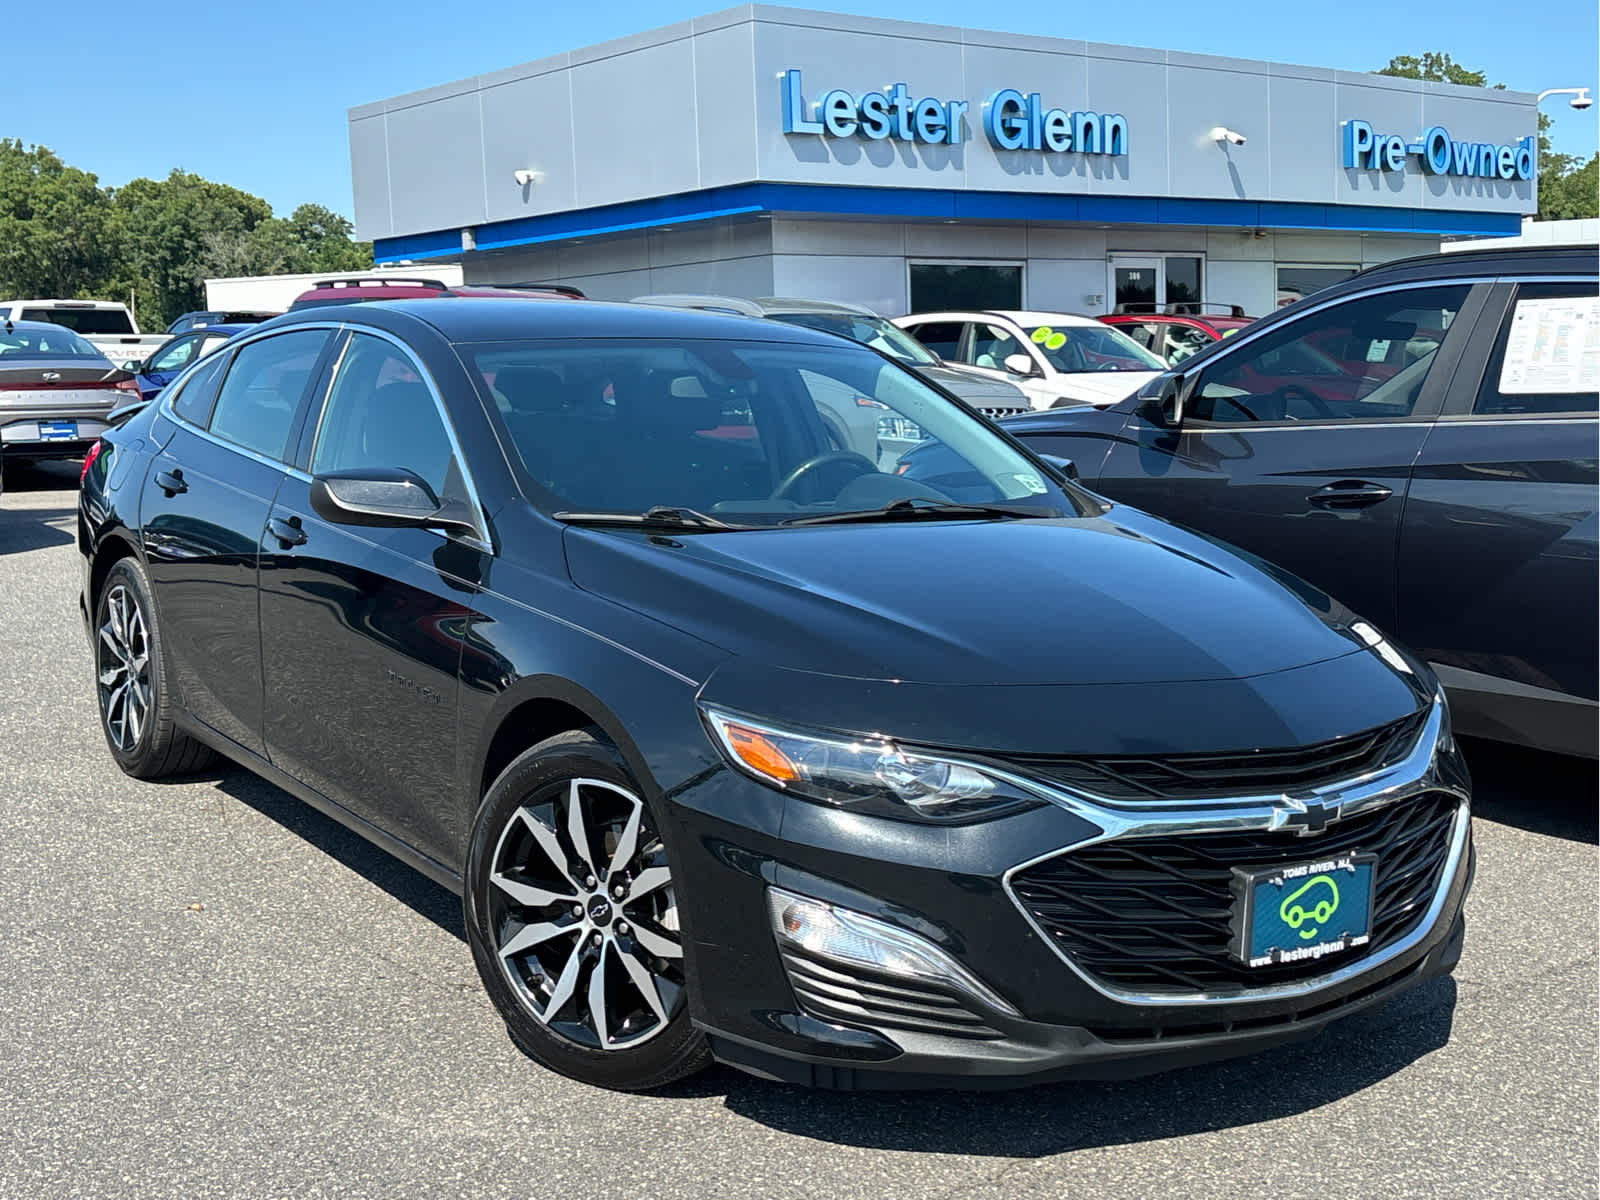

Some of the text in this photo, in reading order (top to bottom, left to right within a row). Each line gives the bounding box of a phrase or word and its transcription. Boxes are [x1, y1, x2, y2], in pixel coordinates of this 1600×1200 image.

[781, 69, 1129, 155] Lester Glenn
[1344, 119, 1535, 181] Pre-Owned
[1282, 866, 1308, 879] TOMS
